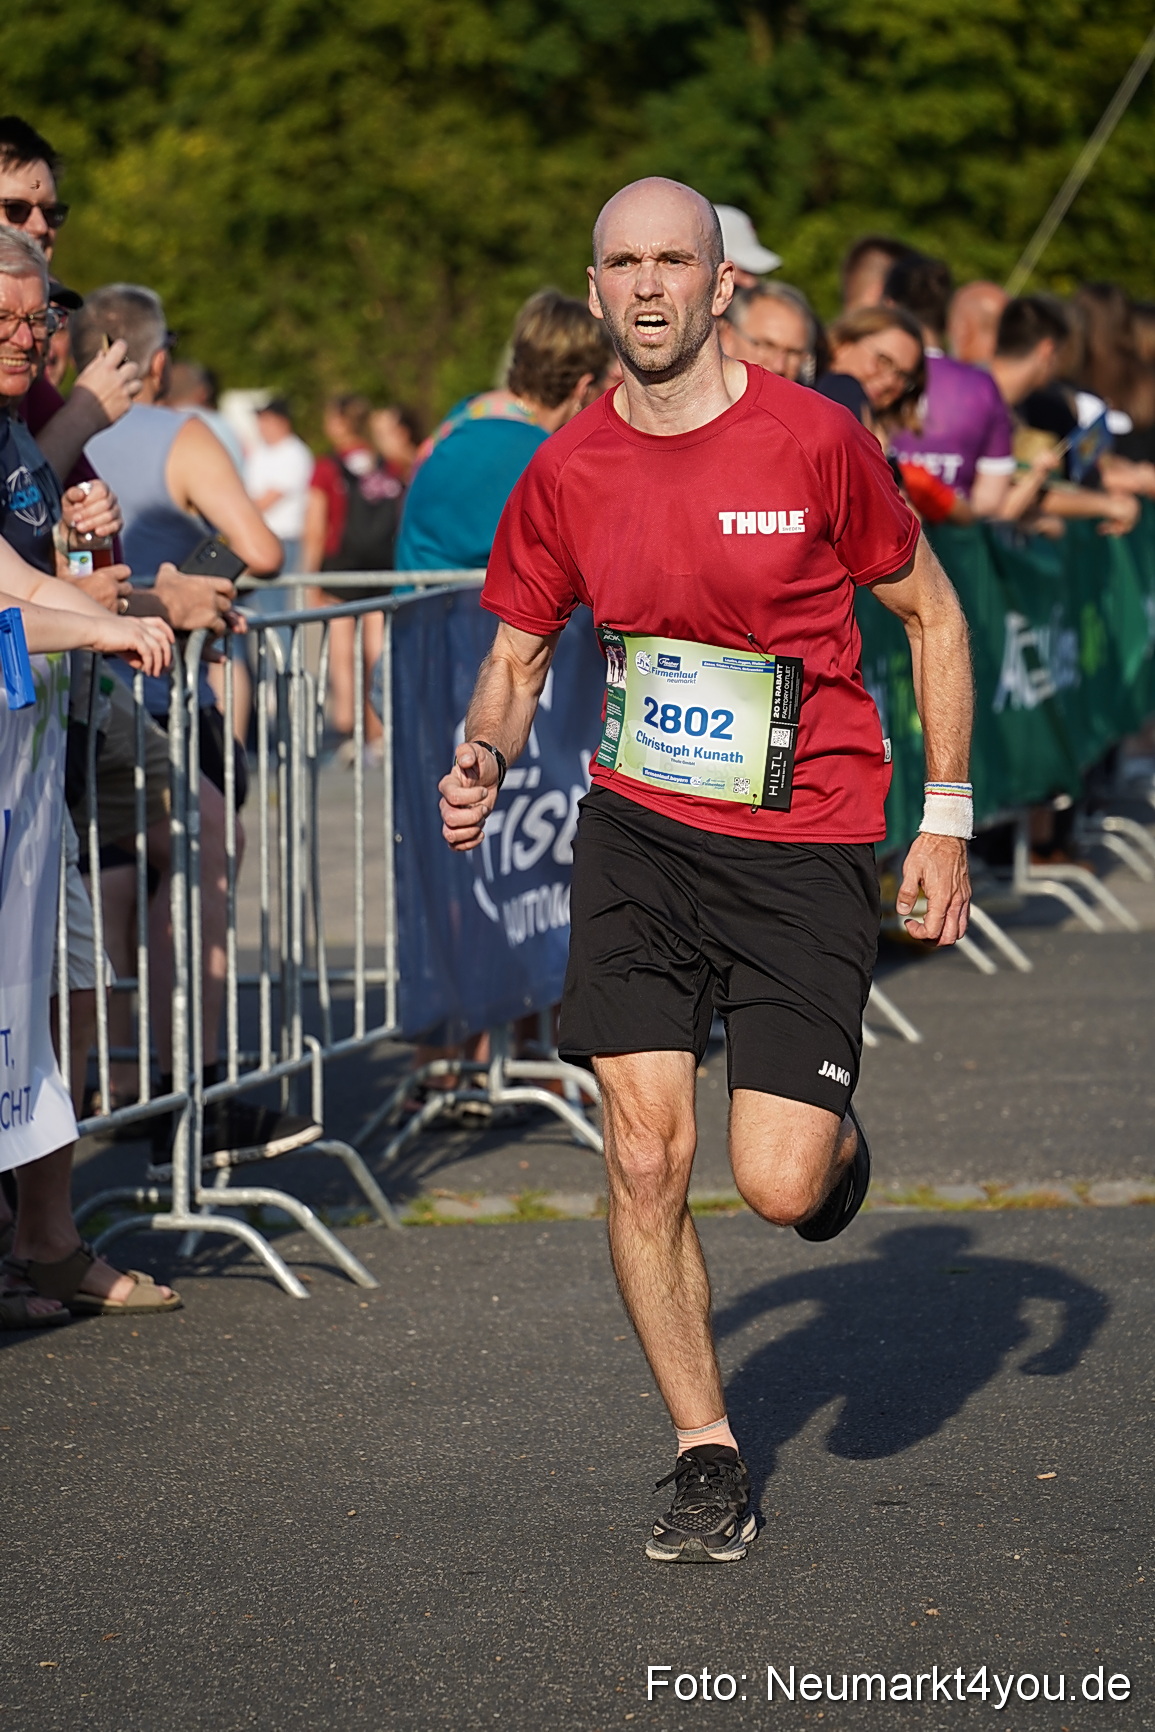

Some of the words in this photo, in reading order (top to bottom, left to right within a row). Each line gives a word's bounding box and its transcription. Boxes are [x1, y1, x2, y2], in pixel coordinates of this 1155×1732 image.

[718, 510, 805, 535] THULE
[603, 634, 622, 642] AOK
[651, 666, 698, 679] Firmenlauf
[774, 664, 783, 697] RABATT
[643, 696, 734, 741] 2802
[773, 706, 780, 718] 20
[636, 730, 692, 758] Christoph
[694, 746, 744, 764] Kunath
[768, 752, 783, 796] HILTL
[818, 1060, 851, 1087] JAKO
